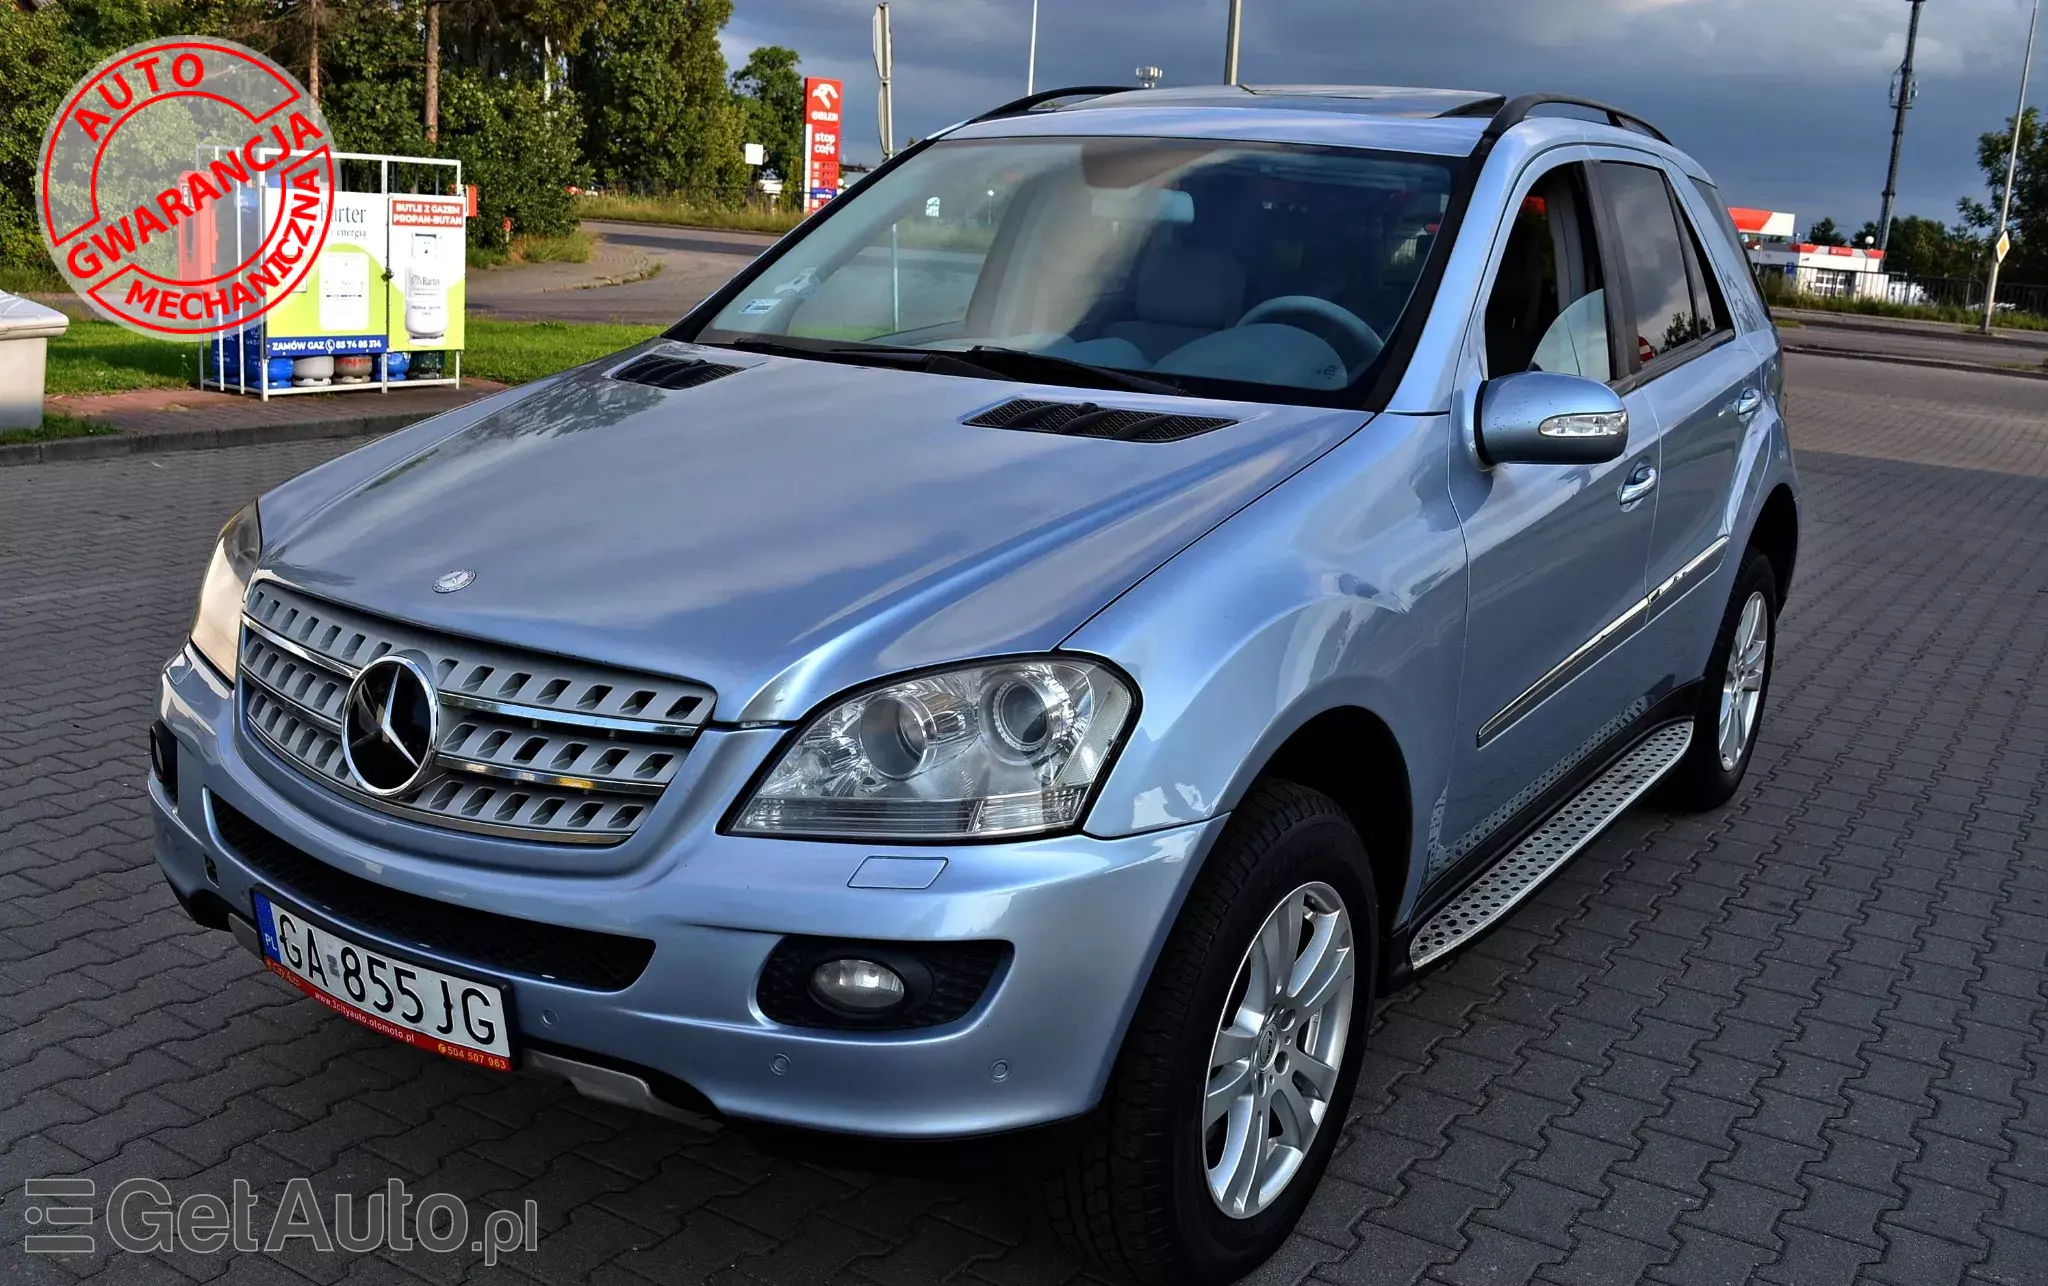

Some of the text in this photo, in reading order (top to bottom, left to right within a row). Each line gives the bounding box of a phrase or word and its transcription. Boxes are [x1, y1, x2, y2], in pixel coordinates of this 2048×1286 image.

[814, 132, 836, 145] stop
[395, 203, 422, 213] BUTLE
[424, 204, 430, 213] Z
[393, 213, 462, 225] PROPAN-BUTAN
[272, 340, 306, 351] ZAMÓW
[307, 341, 325, 350] GAZ
[347, 340, 357, 349] 74
[264, 933, 278, 951] PL
[279, 913, 496, 1045] GA 855JG
[314, 991, 415, 1043] www.3cityauto.otomoto.pl
[447, 1046, 506, 1069] 504 507 963
